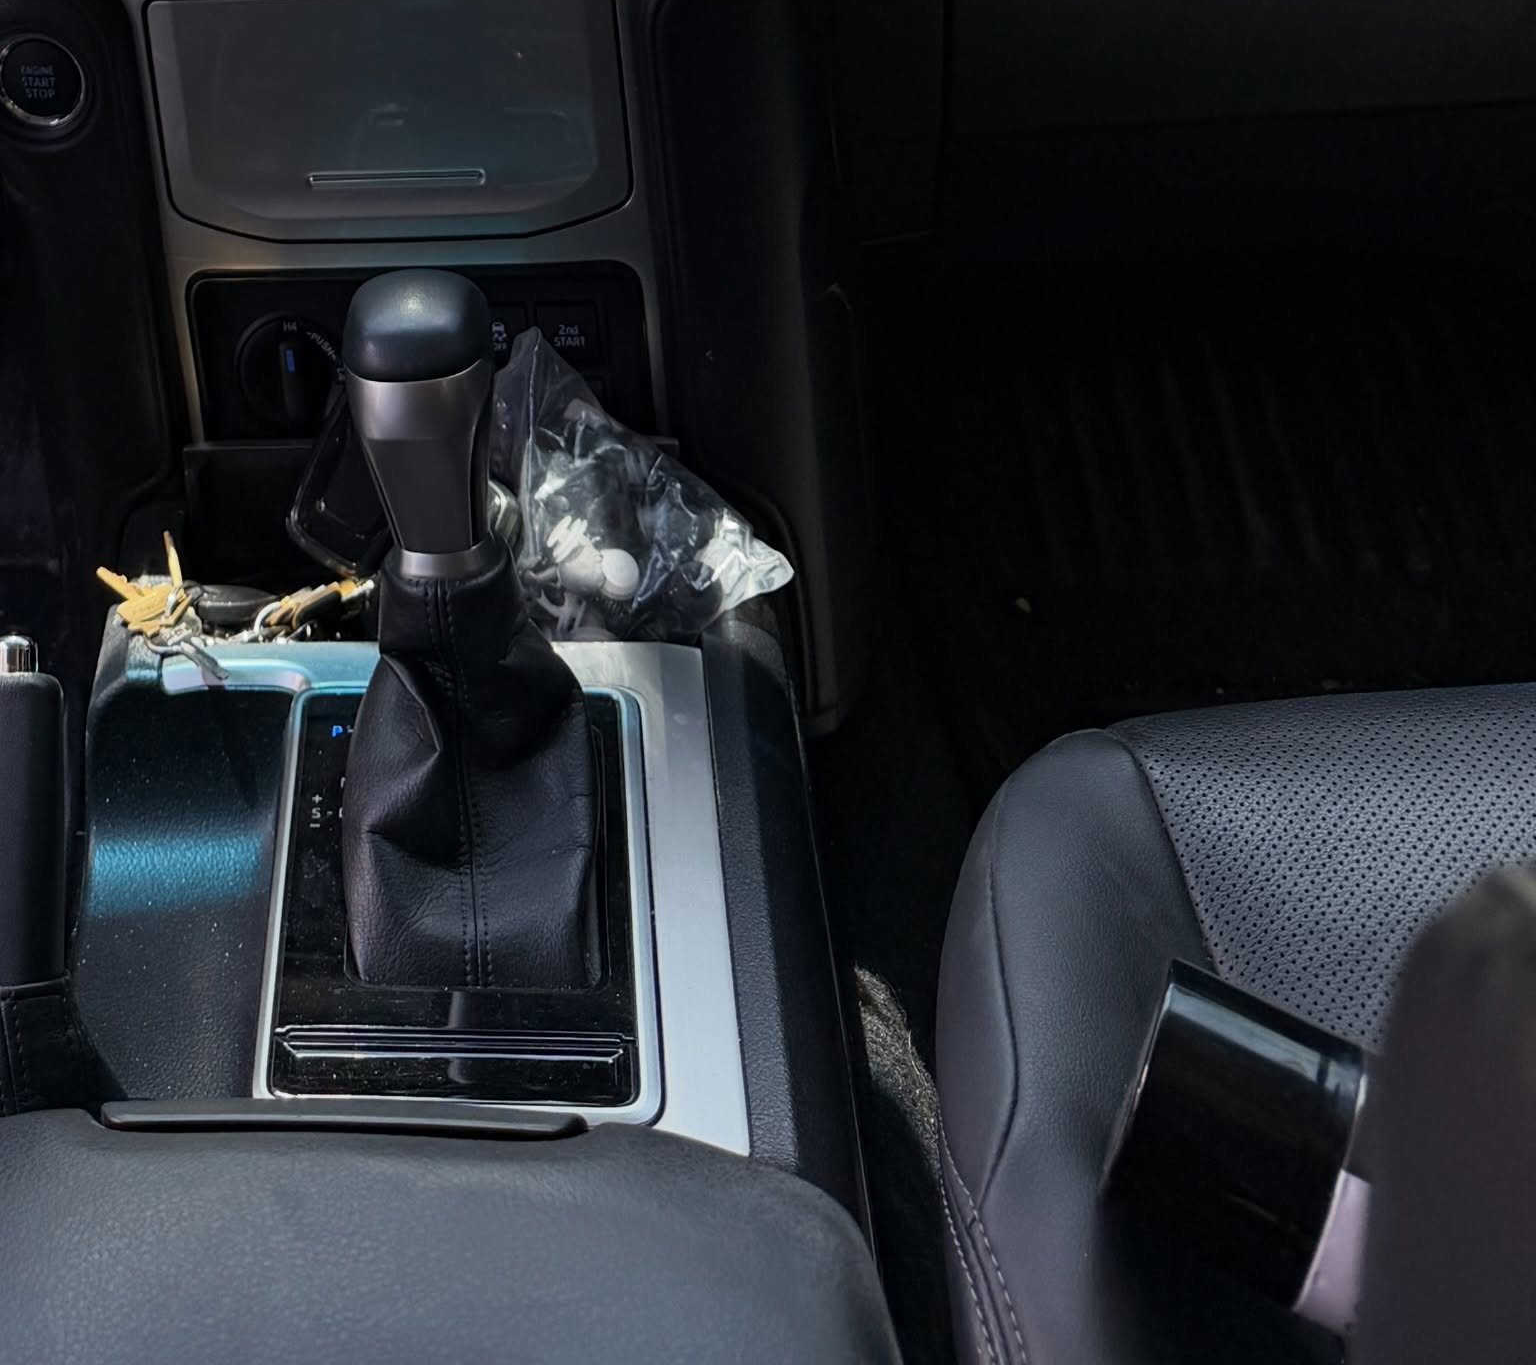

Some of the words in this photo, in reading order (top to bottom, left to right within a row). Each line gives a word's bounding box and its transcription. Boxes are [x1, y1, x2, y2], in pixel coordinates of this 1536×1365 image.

[25, 88, 56, 99] STOP
[553, 335, 586, 347] START
[332, 724, 344, 738] P
